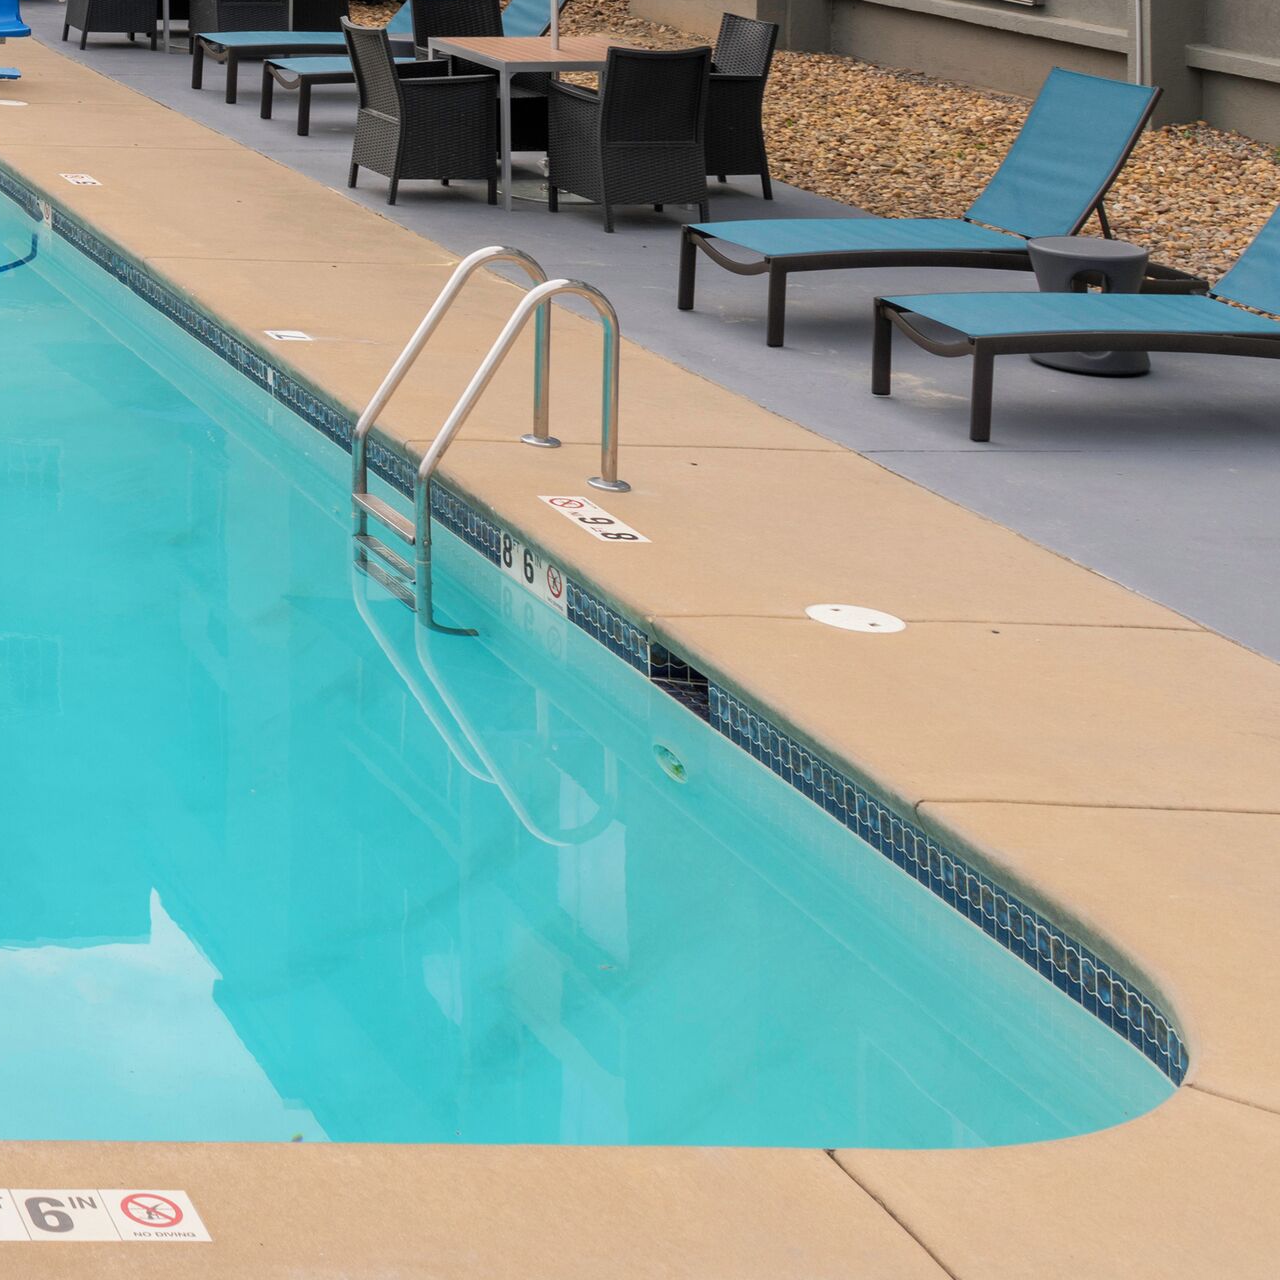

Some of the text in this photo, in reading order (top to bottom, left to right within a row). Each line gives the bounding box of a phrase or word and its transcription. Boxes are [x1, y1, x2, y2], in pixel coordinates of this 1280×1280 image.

[503, 533, 513, 569] 8
[524, 548, 534, 584] 6
[24, 1196, 74, 1233] 6
[69, 1196, 98, 1210] IN
